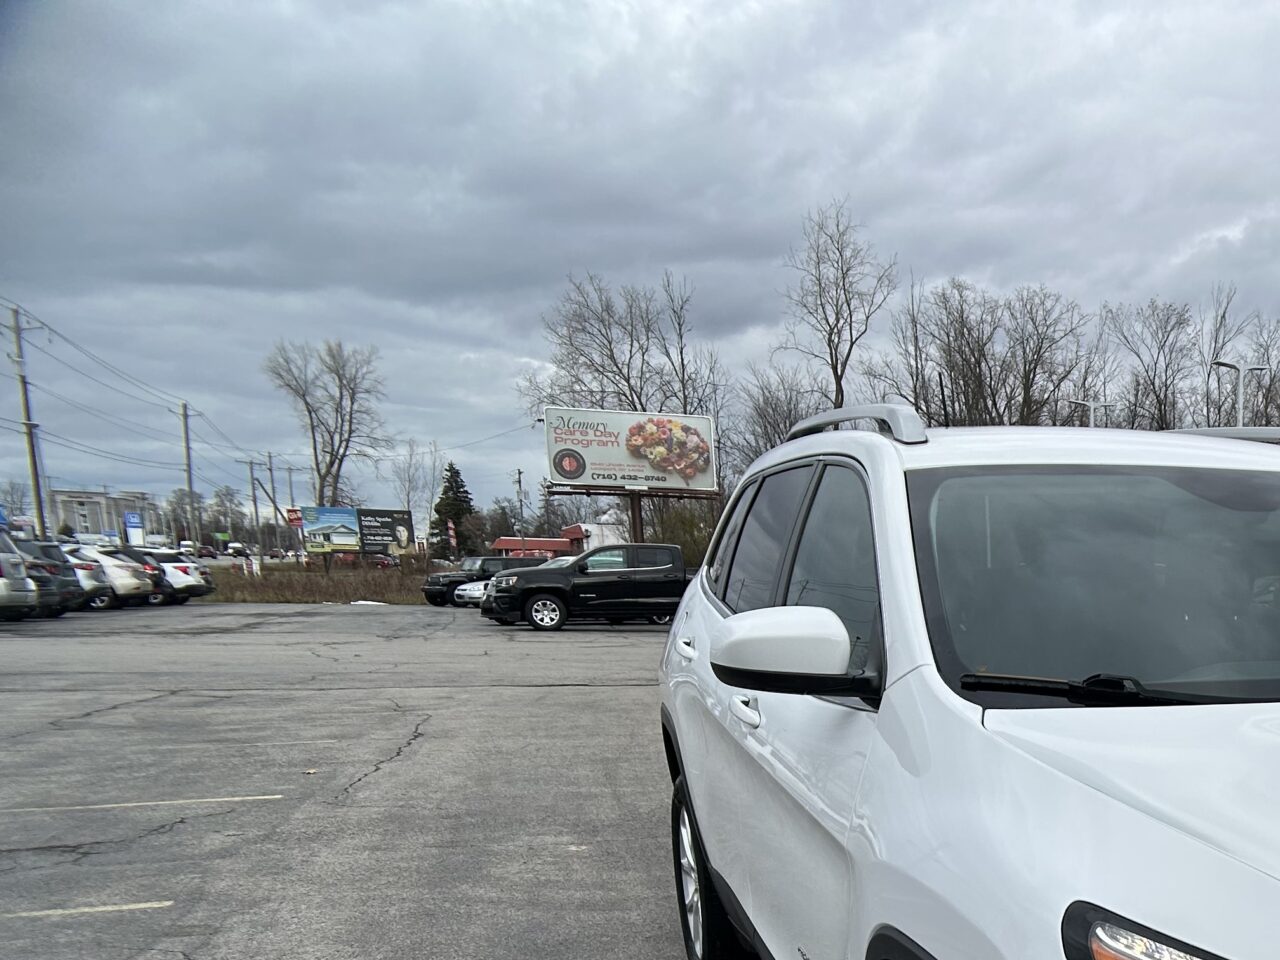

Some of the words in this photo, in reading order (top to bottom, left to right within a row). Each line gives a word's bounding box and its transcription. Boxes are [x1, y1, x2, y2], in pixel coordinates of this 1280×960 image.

[550, 416, 607, 432] Memory
[554, 428, 588, 437] Care
[594, 430, 620, 440] Day
[554, 437, 620, 448] Program
[592, 473, 617, 481] (716)
